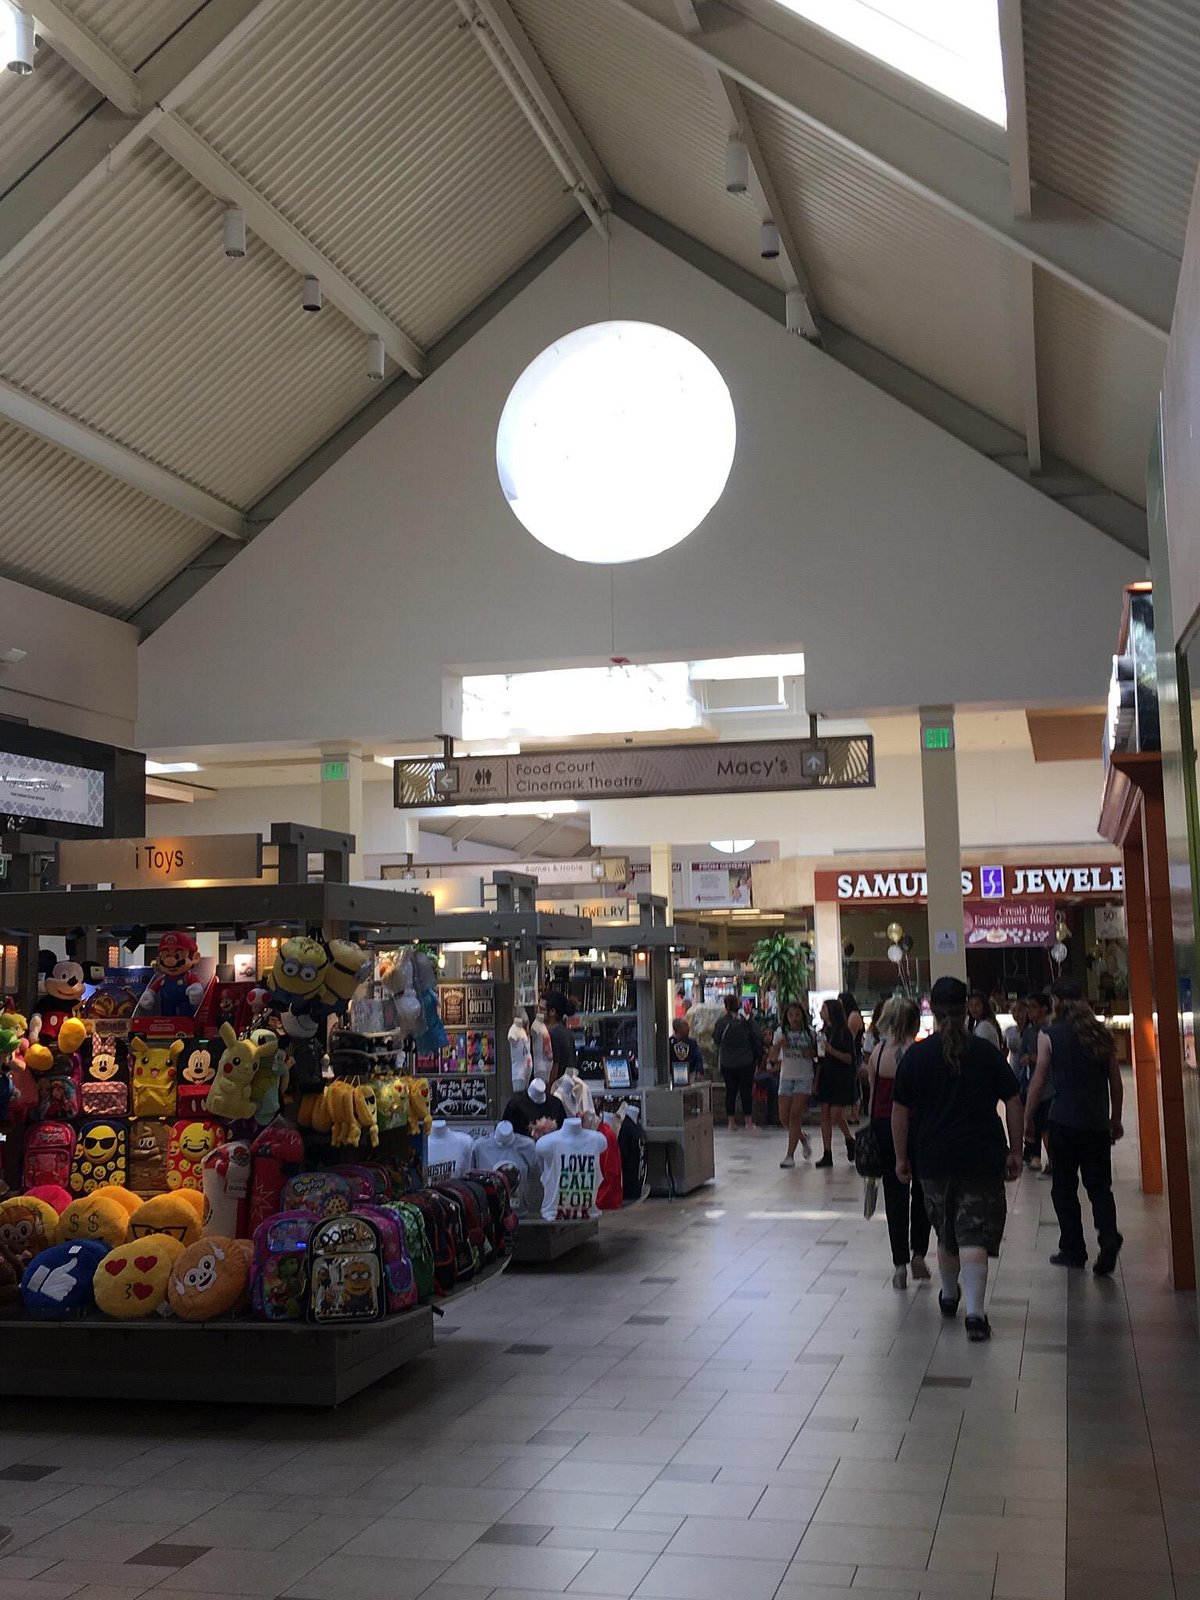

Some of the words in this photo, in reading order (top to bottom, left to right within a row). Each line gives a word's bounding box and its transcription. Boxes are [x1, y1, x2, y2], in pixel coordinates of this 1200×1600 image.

[926, 728, 949, 748] EXIT
[516, 763, 550, 775] Food
[555, 761, 595, 774] Court
[717, 756, 788, 776] Macy's
[516, 778, 584, 792] Cinemark
[588, 776, 643, 789] Theatre
[135, 846, 139, 869] i
[144, 845, 184, 874] Toys
[838, 871, 973, 898] SAMUS
[998, 905, 1028, 916] Create
[1030, 904, 1050, 915] Your
[974, 914, 1028, 927] Engagement
[1030, 913, 1050, 925] Ring
[469, 999, 492, 1013] OUTTA
[561, 1154, 595, 1172] LOVE
[559, 1173, 595, 1189] CALI
[558, 1191, 593, 1207] FOR
[319, 1228, 357, 1246] OOPS
